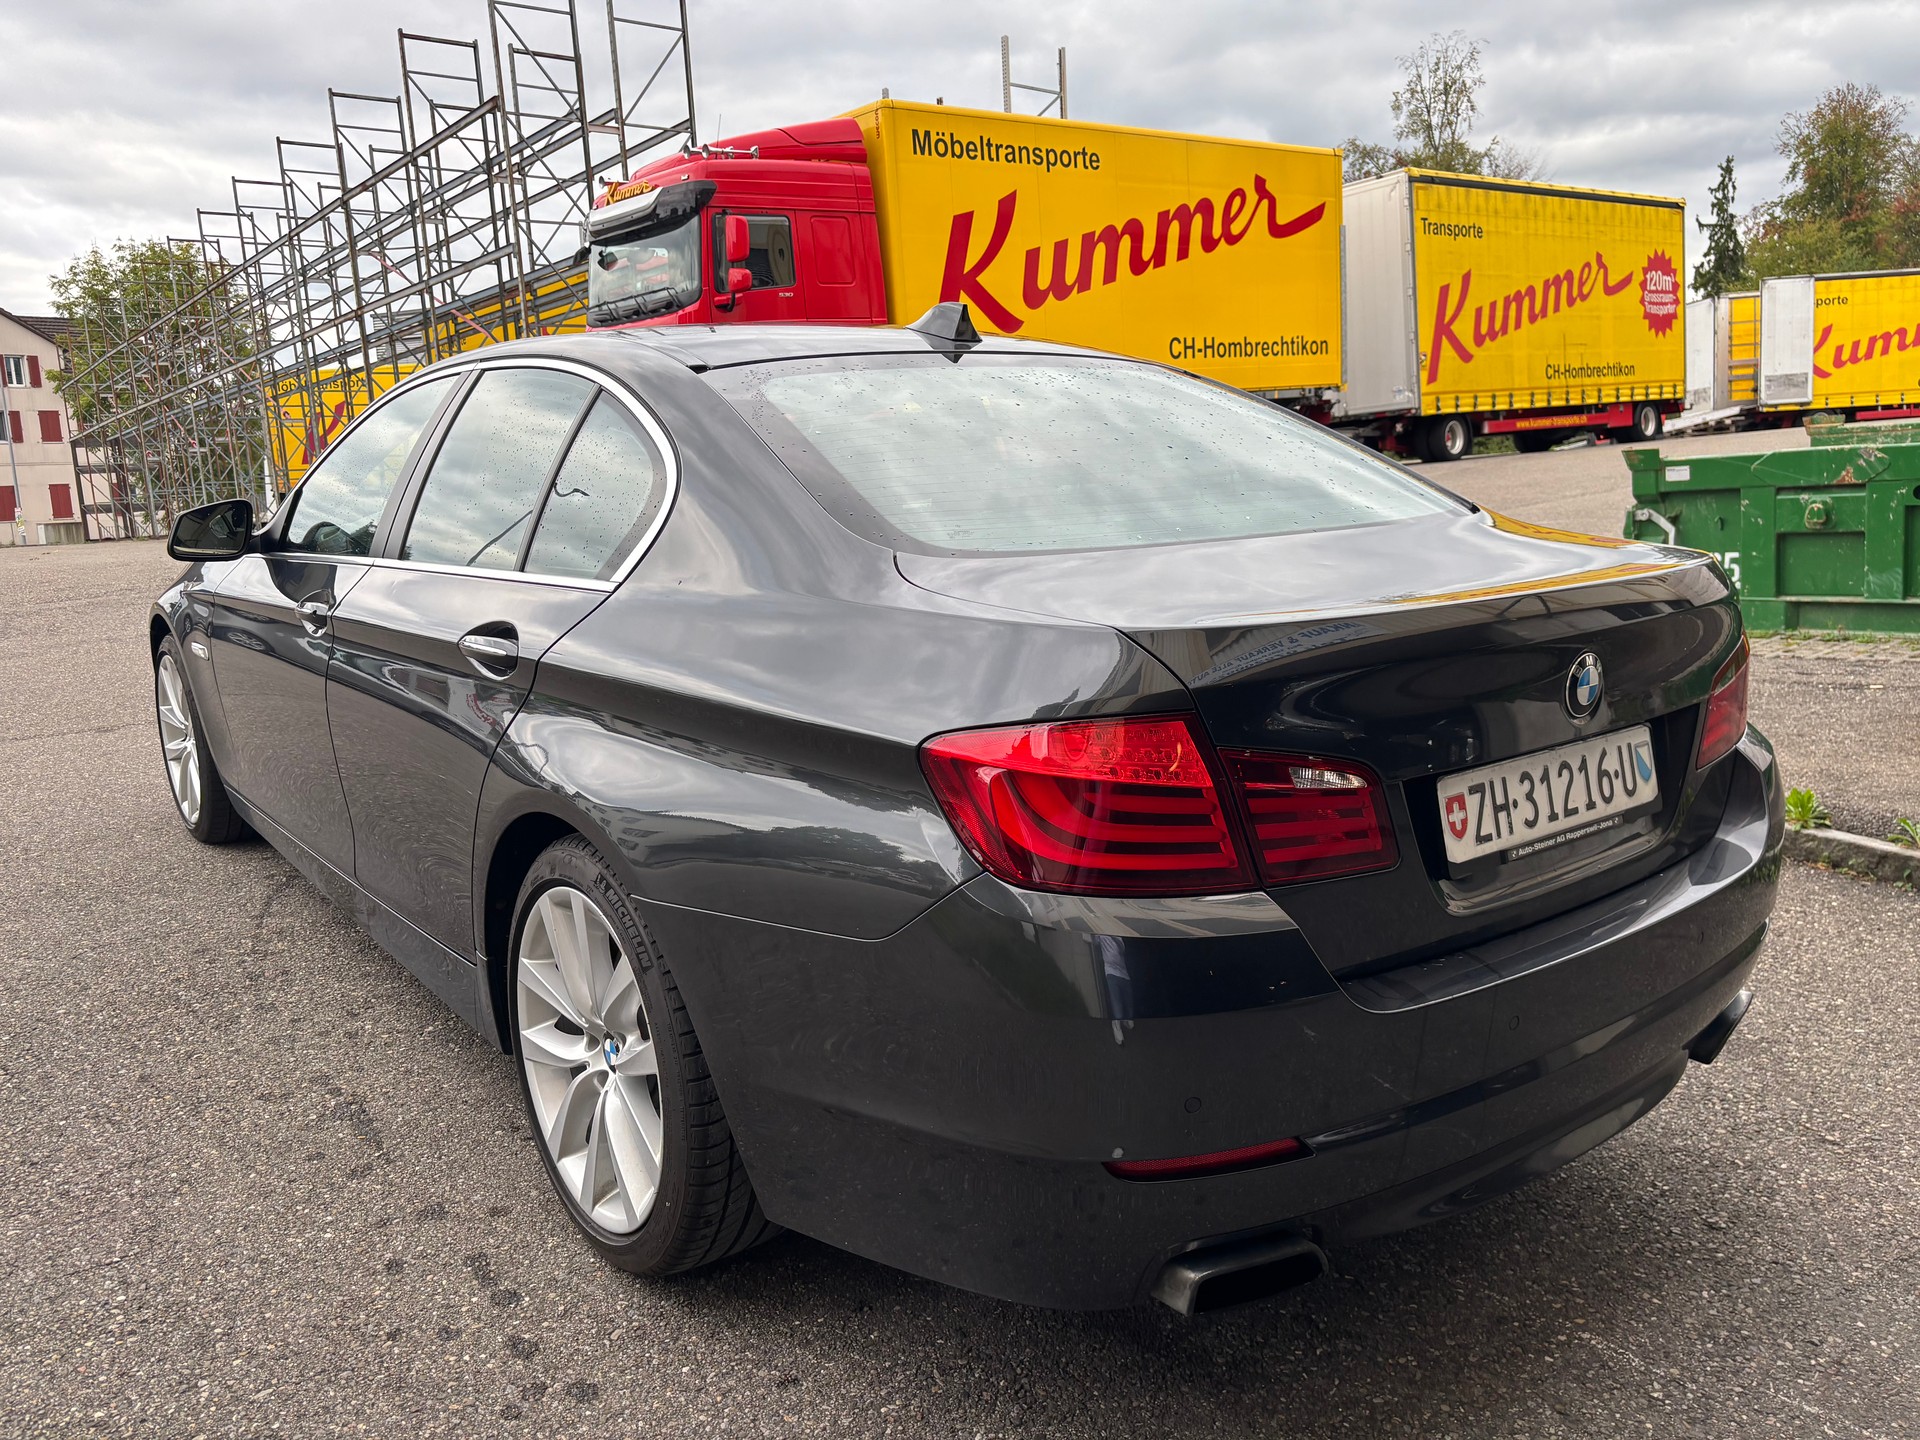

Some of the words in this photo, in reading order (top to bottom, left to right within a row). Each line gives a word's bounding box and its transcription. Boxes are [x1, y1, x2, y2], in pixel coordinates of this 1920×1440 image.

[911, 128, 1101, 173] Möbeltransporte
[605, 181, 653, 206] Kummer
[1420, 217, 1484, 241] Transporte
[938, 173, 1327, 334] Kummer
[1814, 295, 1849, 308] porte
[1426, 251, 1634, 385] Kummer
[1169, 336, 1329, 360] CH-Hombrechtikon
[1545, 363, 1636, 380] CH-Hombrechtikon
[1518, 838, 1556, 856] Auto-Steiner
[606, 888, 652, 968] MICHELIN
